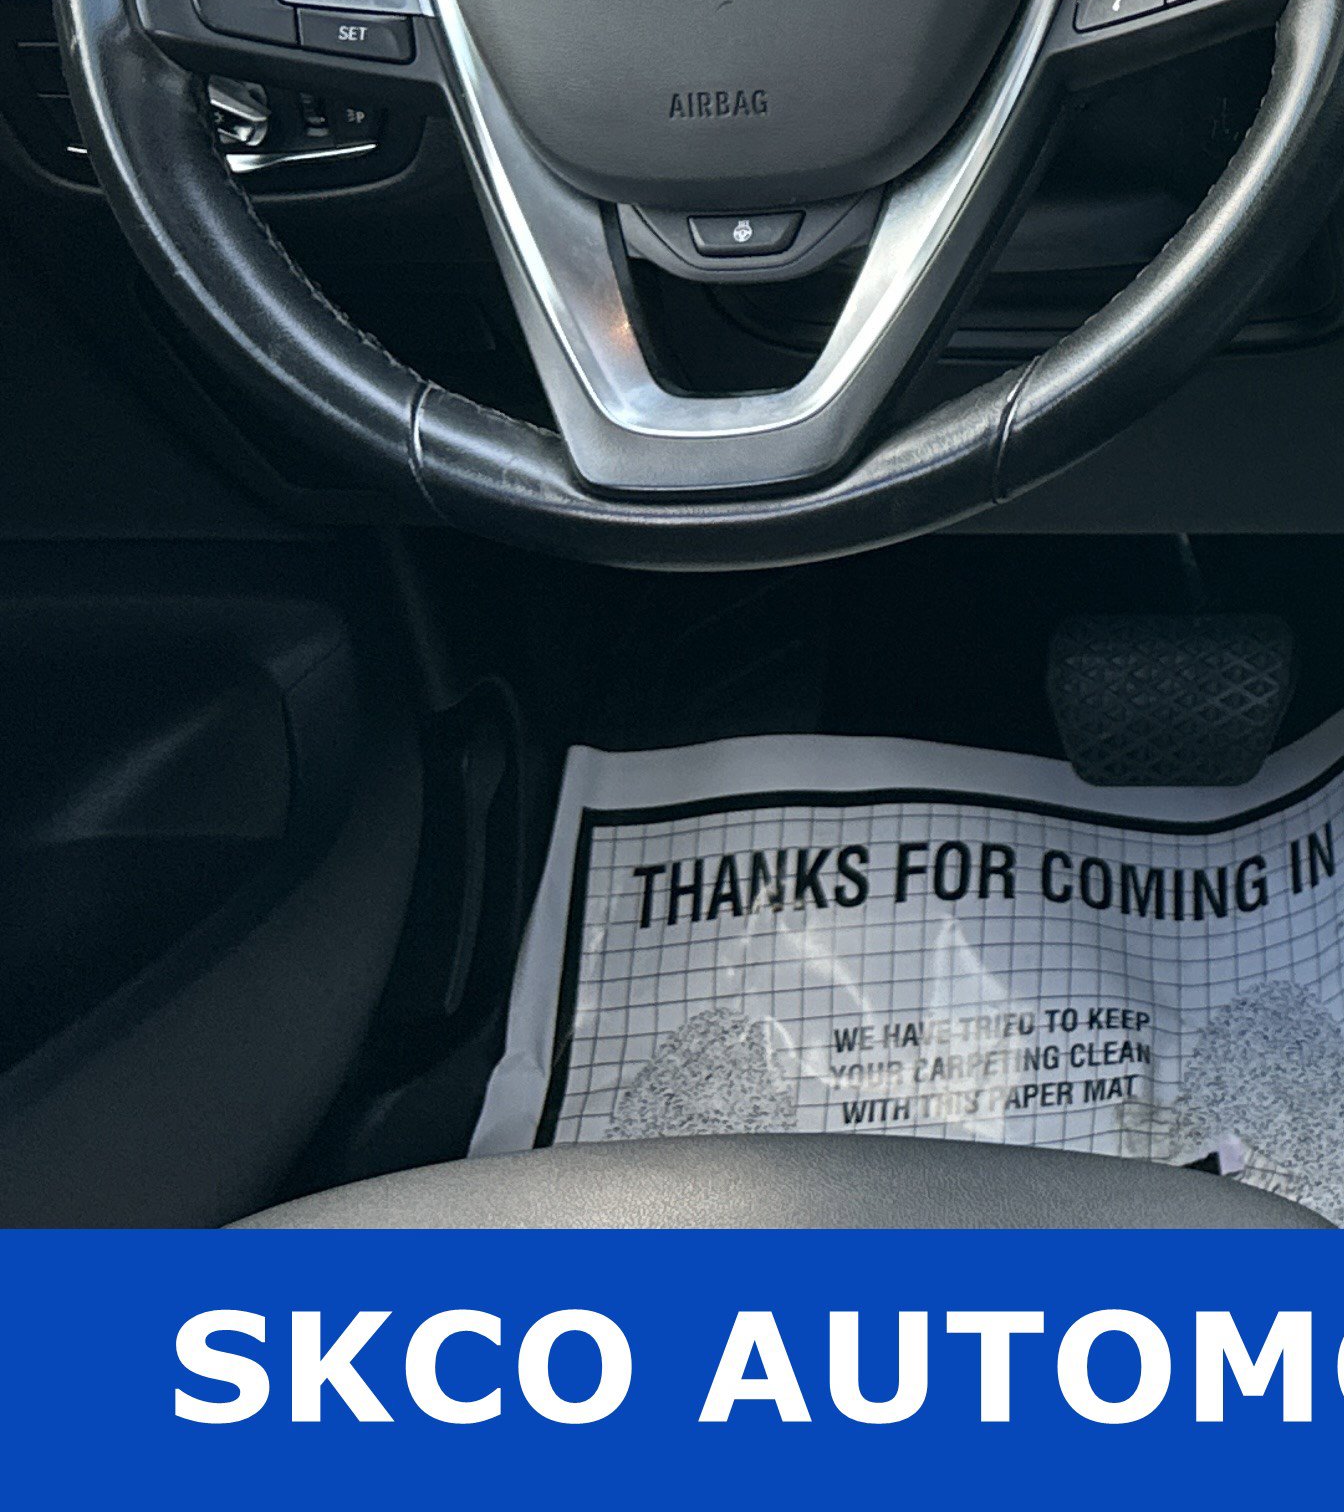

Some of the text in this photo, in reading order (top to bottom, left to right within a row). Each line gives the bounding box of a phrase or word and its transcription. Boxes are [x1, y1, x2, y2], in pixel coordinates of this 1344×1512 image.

[338, 26, 368, 42] SET
[668, 89, 769, 119] AIRBAG
[633, 821, 1336, 929] THANKS FOR COMING IN
[833, 1026, 875, 1054] WE
[883, 1018, 951, 1048] HAVE
[1045, 1007, 1078, 1034] TO
[1088, 1007, 1151, 1033] KEEP
[830, 1039, 1151, 1090] YOUR CARPETING CLEAN
[842, 1097, 911, 1126] WITH
[988, 1080, 1074, 1113] PAPER
[1083, 1074, 1140, 1104] MAT
